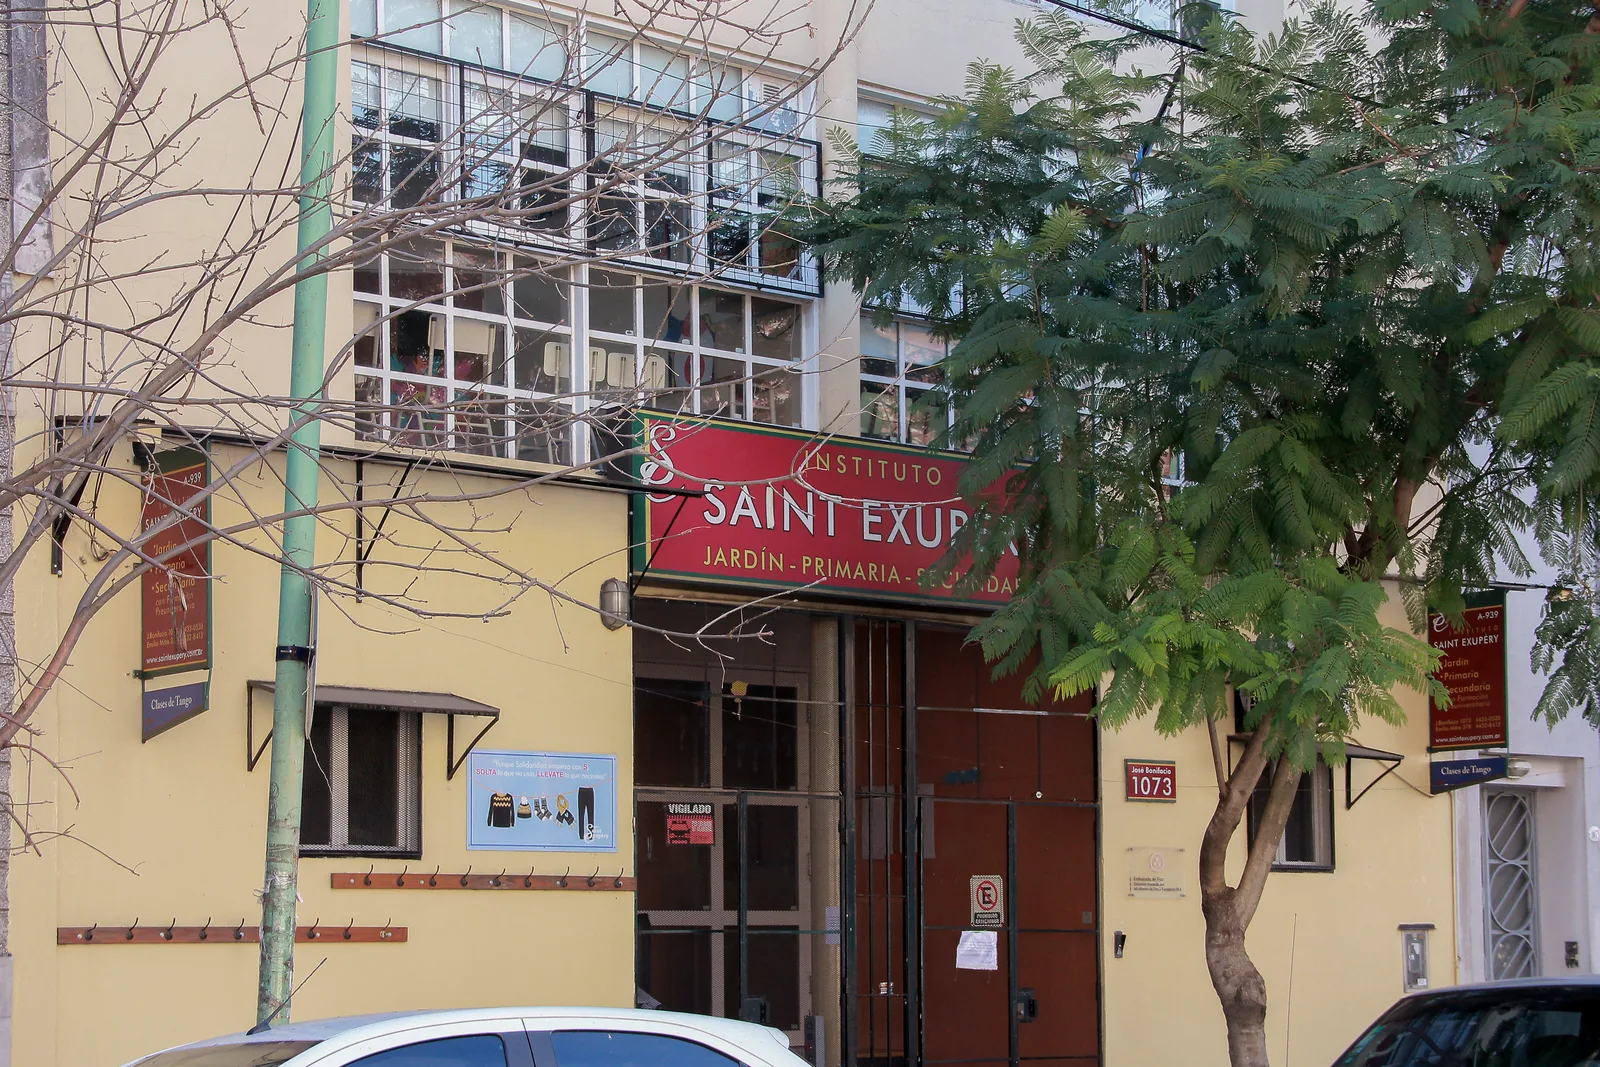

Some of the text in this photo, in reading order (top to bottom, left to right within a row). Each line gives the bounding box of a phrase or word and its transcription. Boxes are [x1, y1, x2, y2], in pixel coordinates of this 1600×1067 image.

[804, 450, 942, 486] INSTITUTO
[183, 472, 202, 485] A-939
[703, 478, 842, 537] SAINT
[703, 545, 784, 572] JARDÍN
[802, 555, 901, 584] PRIMARIA
[1477, 610, 1499, 620] A-939
[1433, 639, 1459, 649] SAINT
[1443, 670, 1479, 681] Primaria
[150, 695, 192, 710] Clases de Tango
[1435, 733, 1501, 743] www.saintexupery.com.ar
[476, 768, 497, 776] SOLTA
[1131, 766, 1172, 775] José Bonifacio
[1440, 765, 1492, 776] Clases de Tango
[1132, 776, 1172, 796] 1073
[668, 803, 712, 814] VIGILADO
